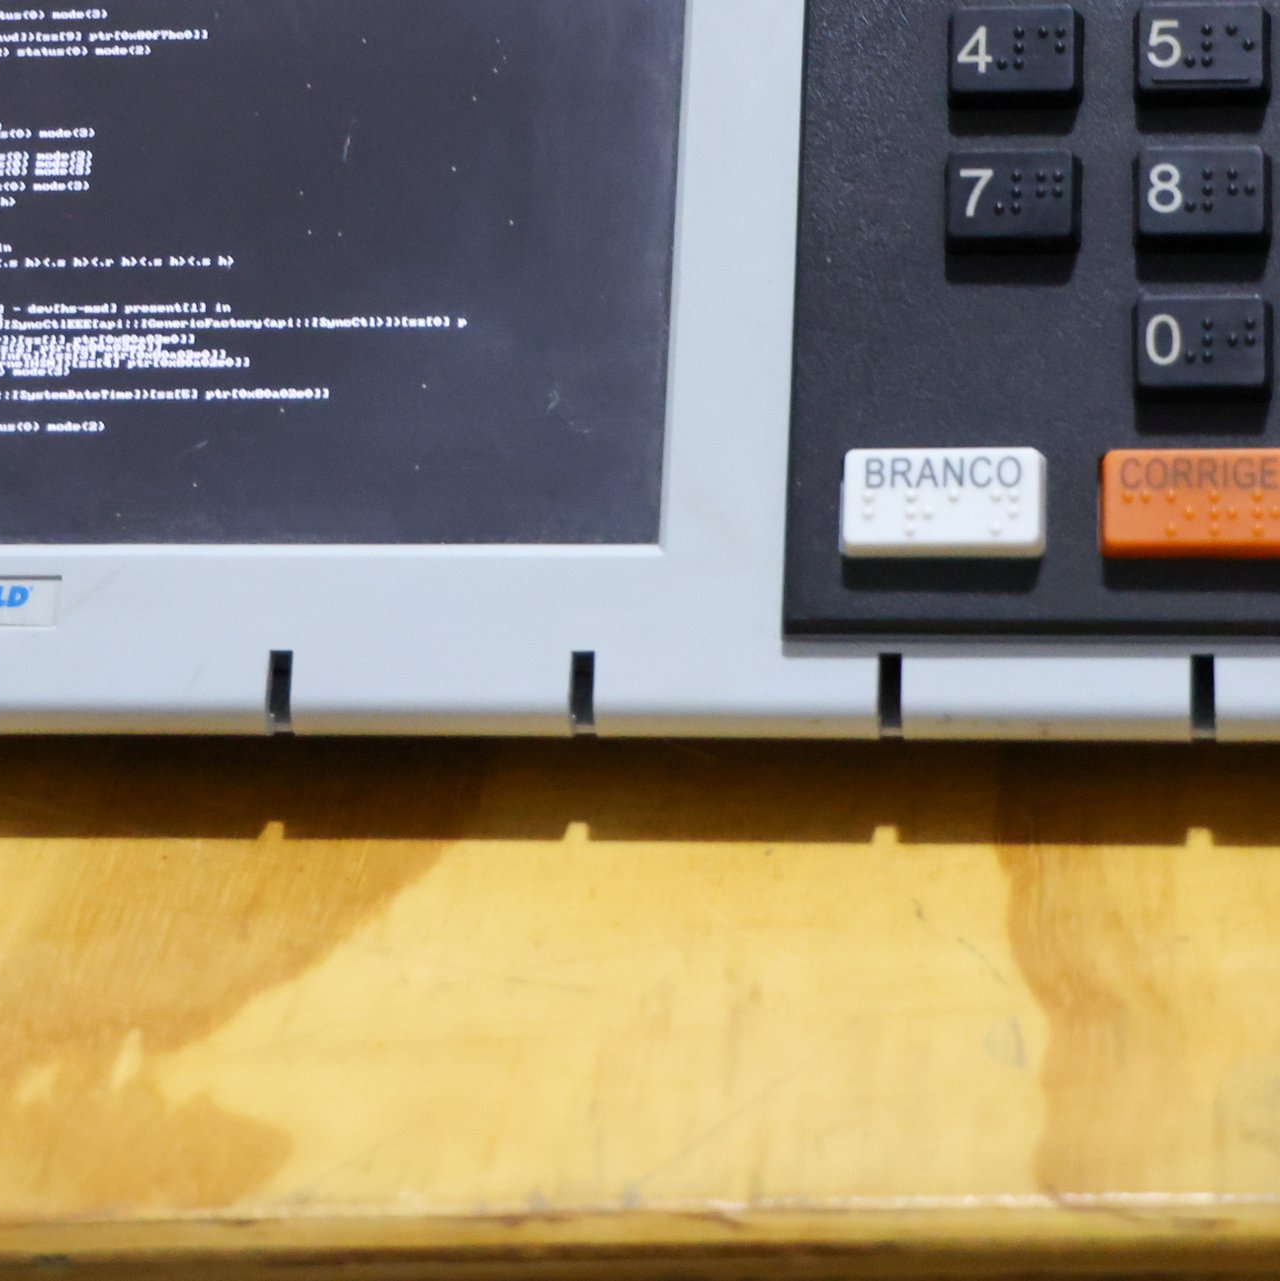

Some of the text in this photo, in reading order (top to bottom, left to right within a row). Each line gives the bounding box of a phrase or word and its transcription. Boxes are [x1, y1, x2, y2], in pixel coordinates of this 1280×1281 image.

[956, 26, 993, 73] 4
[1147, 20, 1182, 68] 5
[959, 169, 994, 217] 7
[1147, 163, 1183, 214] 8
[1144, 314, 1181, 365] 0
[863, 455, 1023, 489] BRANCO
[1119, 456, 1280, 491] CORRIGE
